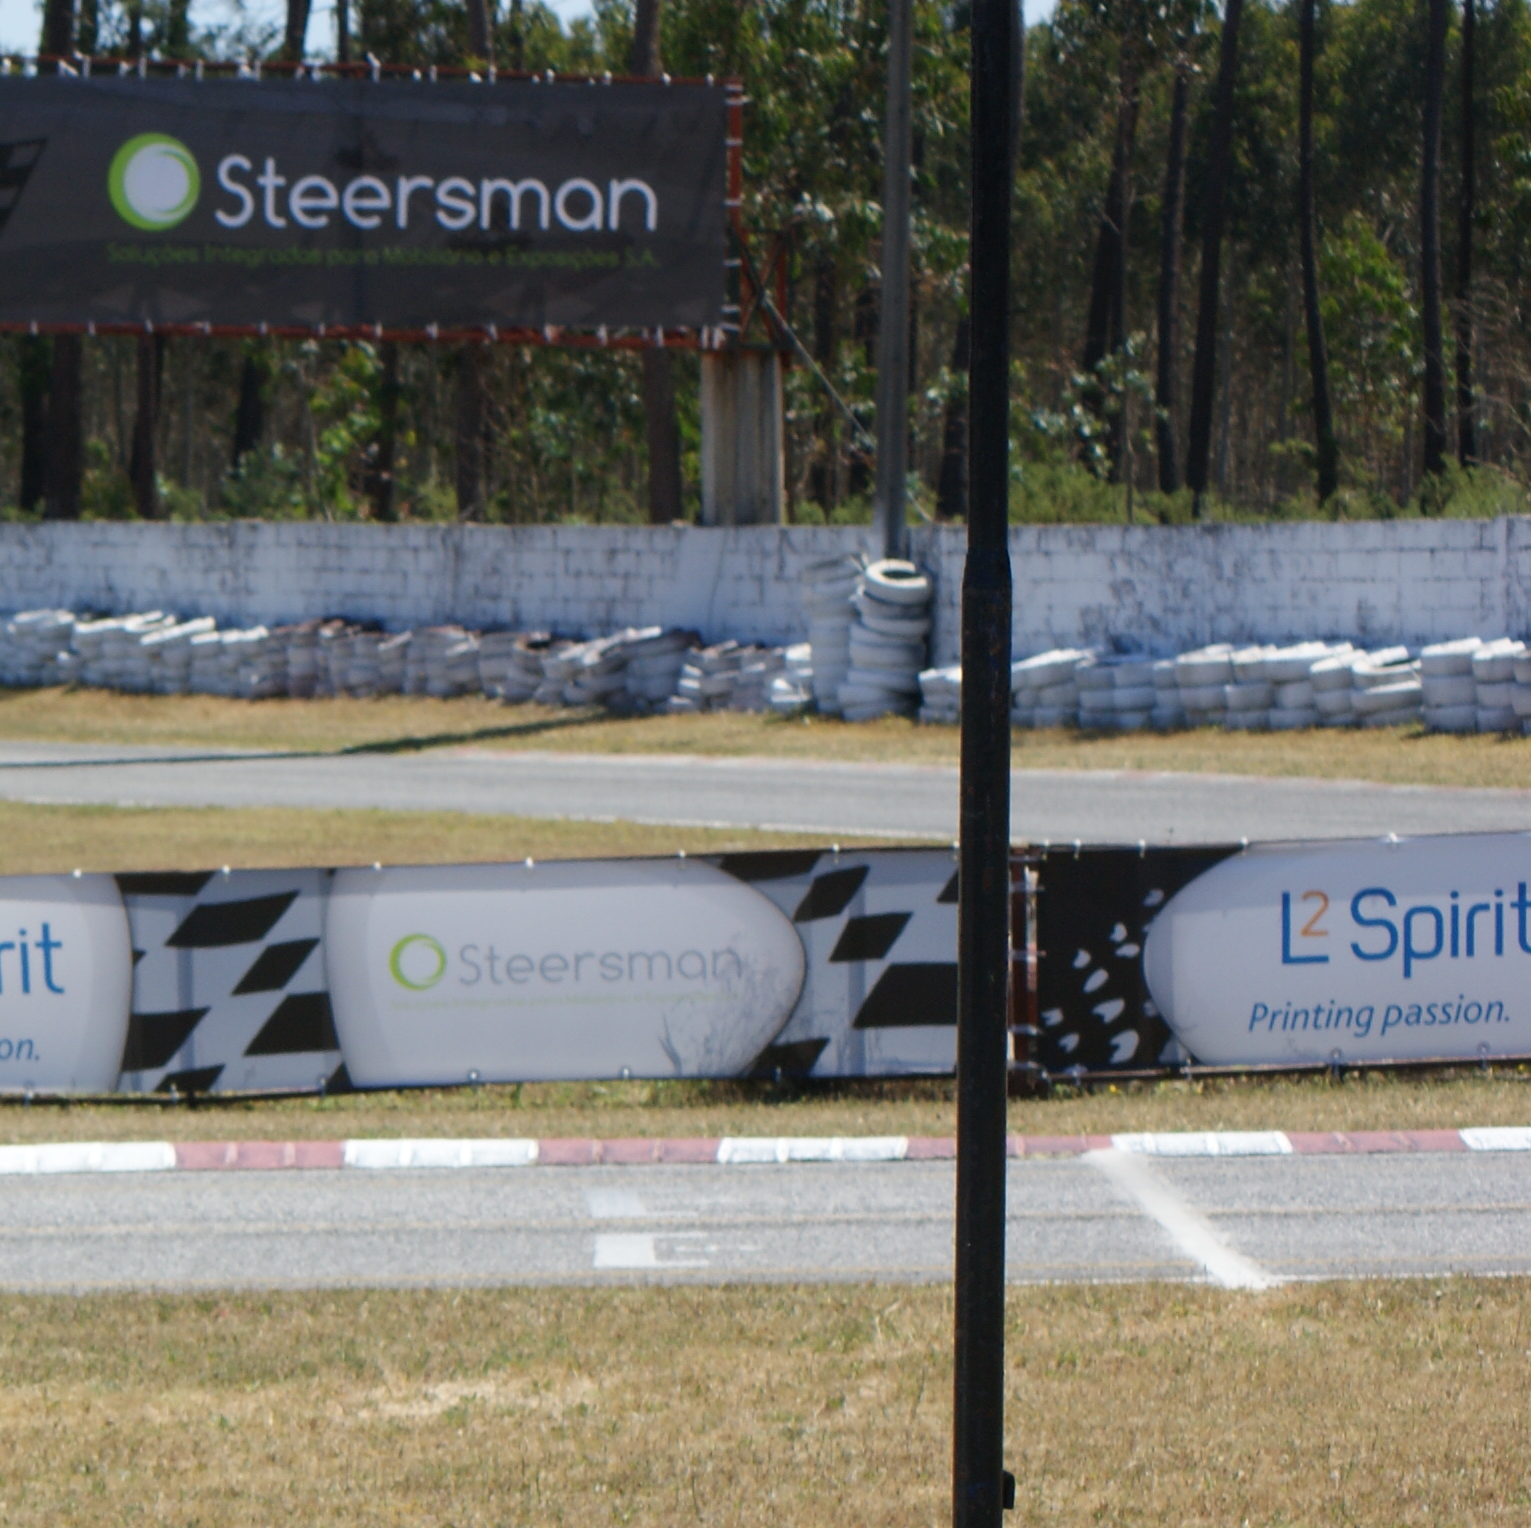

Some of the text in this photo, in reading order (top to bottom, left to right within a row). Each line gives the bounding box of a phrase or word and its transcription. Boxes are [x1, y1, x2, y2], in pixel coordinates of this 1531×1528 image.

[214, 153, 658, 231] Steersman
[1349, 881, 1531, 979] Spirit
[458, 942, 742, 987] Steersman
[1248, 994, 1512, 1037] Printing passion.
